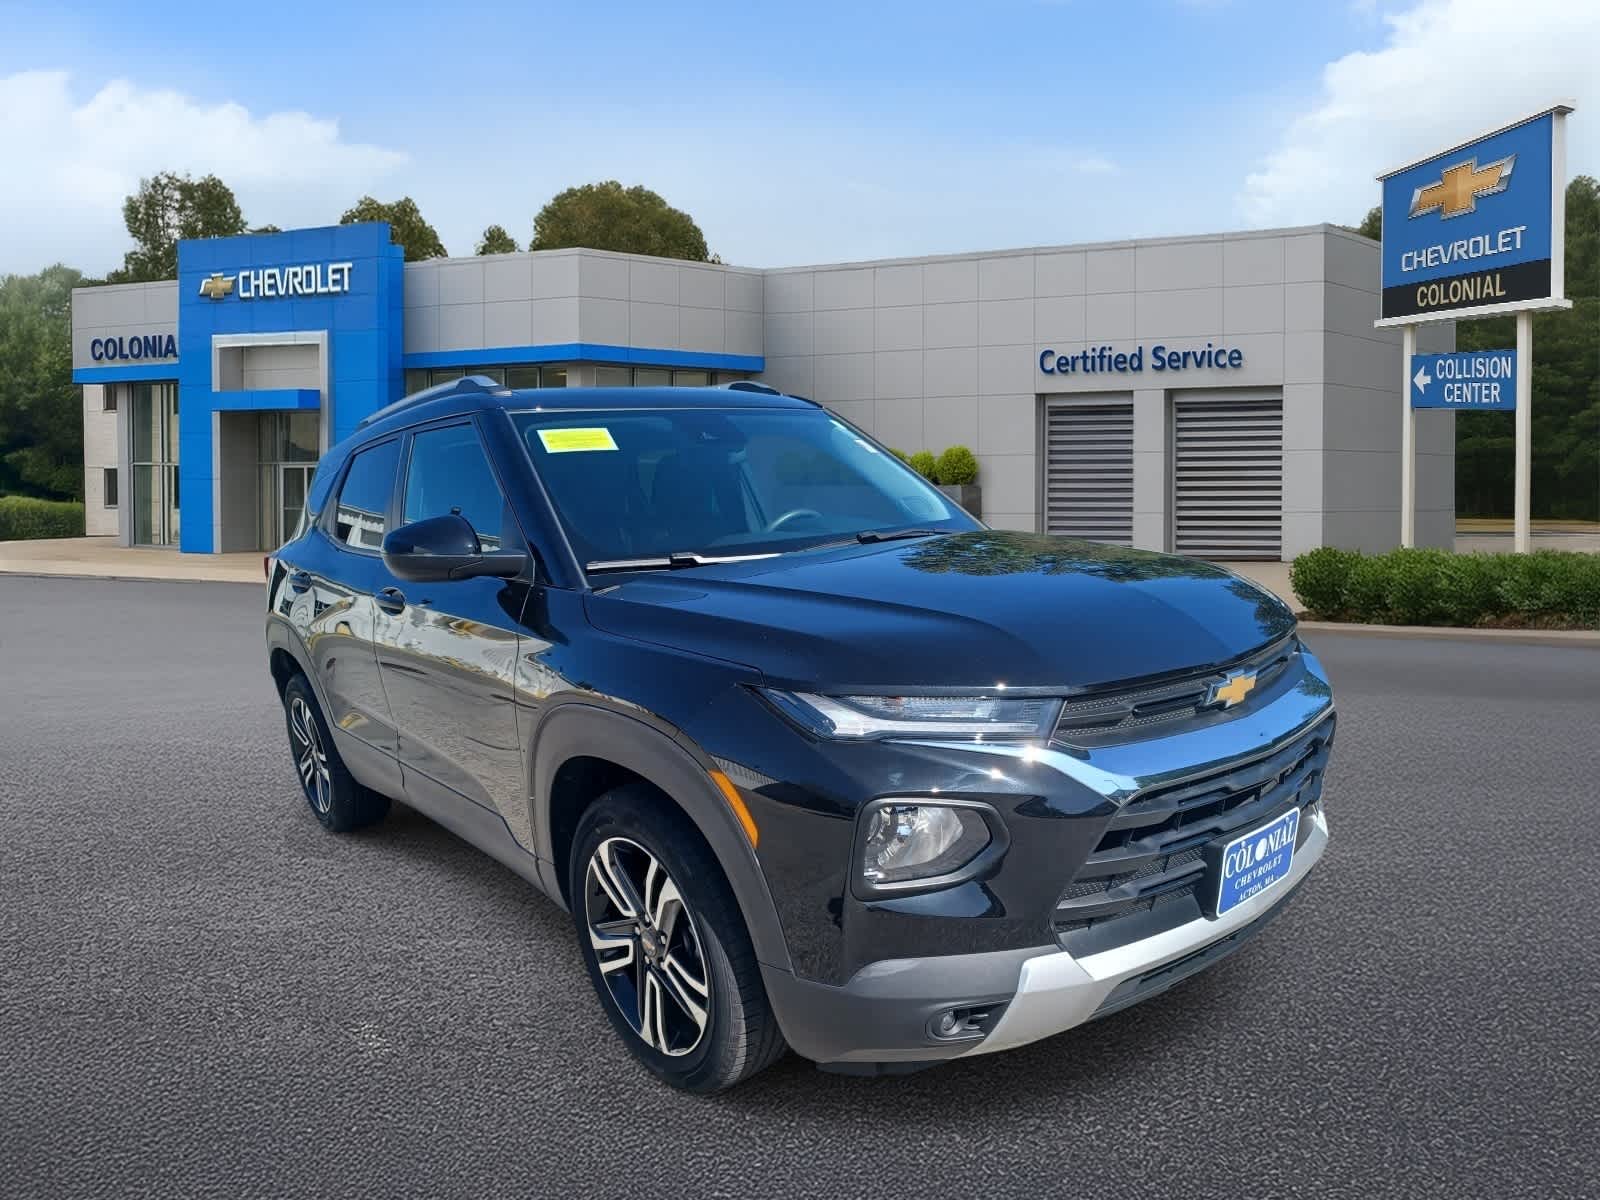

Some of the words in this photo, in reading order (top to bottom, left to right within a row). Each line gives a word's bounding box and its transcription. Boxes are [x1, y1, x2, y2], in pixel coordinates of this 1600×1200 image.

[1401, 226, 1527, 272] CHEVROLET
[238, 262, 353, 298] CHEVROLET
[1416, 273, 1506, 307] COLONIAL
[90, 334, 179, 361] COLONIA
[1039, 345, 1144, 375] Certified
[1151, 343, 1244, 372] Service
[1436, 356, 1512, 380] COLLISION
[1444, 382, 1501, 403] CENTER
[1234, 854, 1283, 890] CHEVROLET
